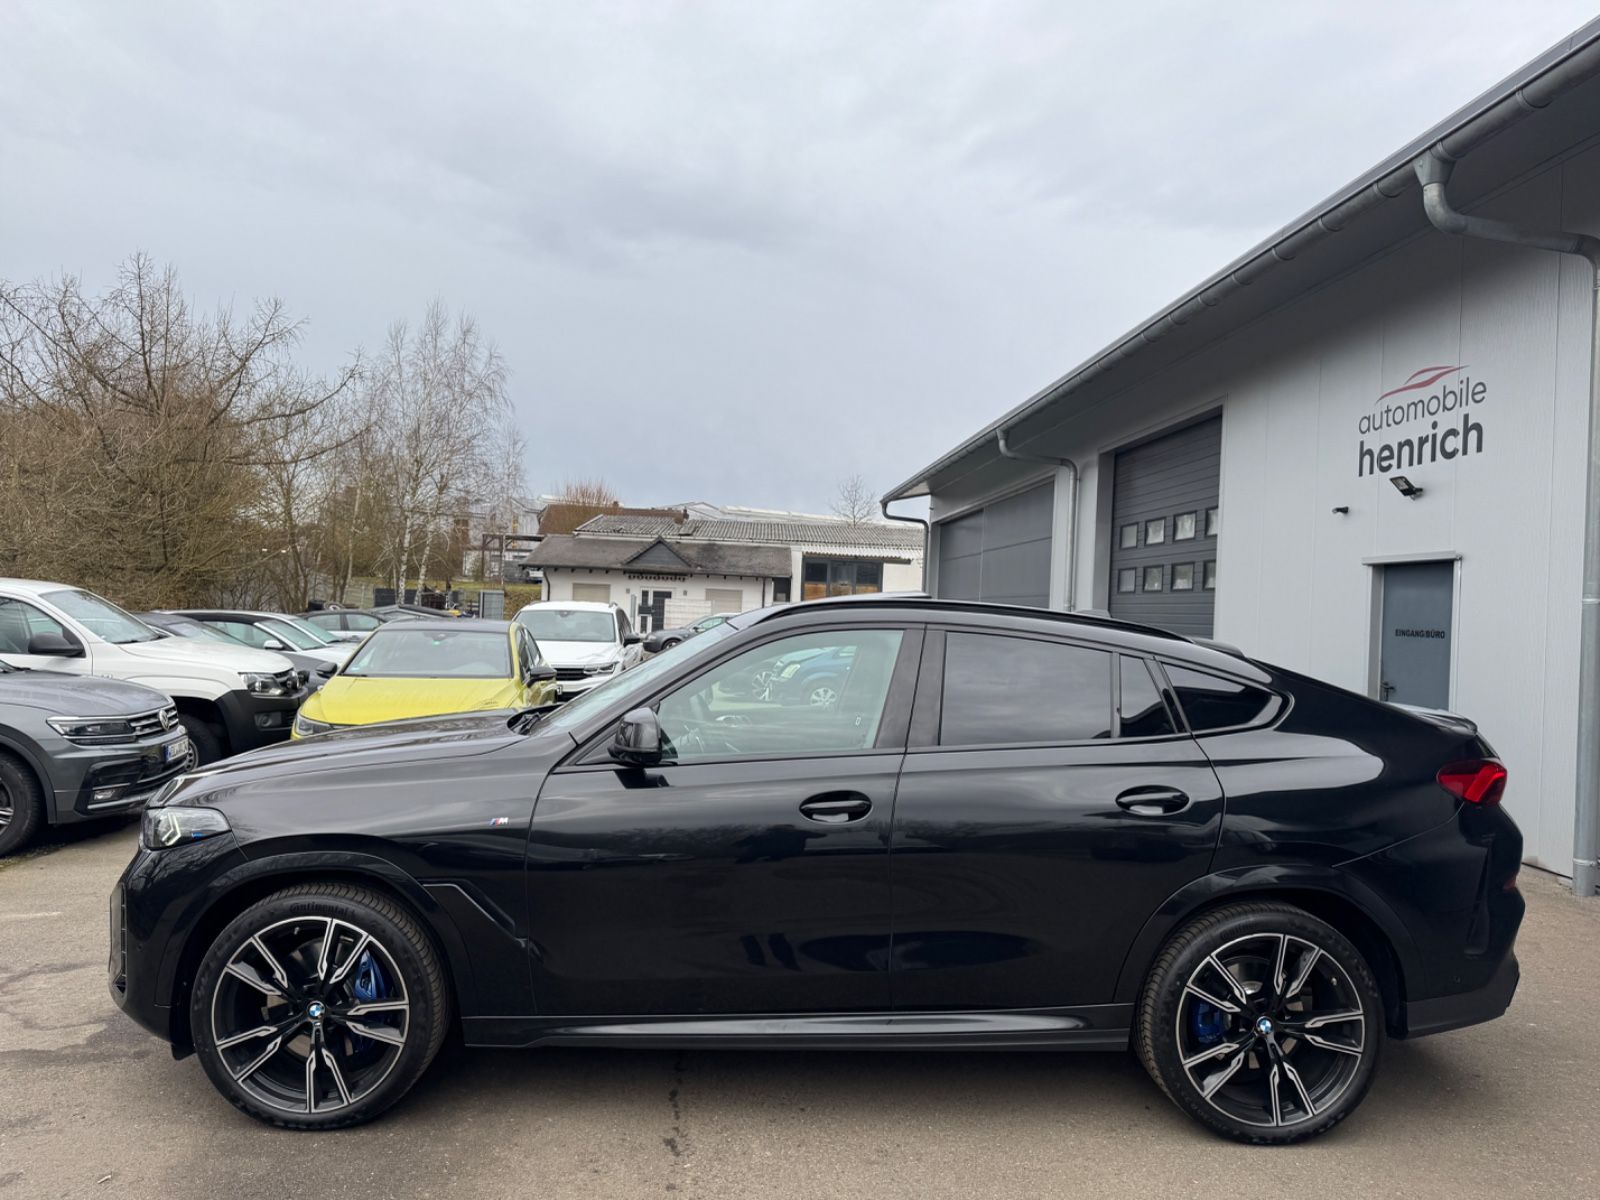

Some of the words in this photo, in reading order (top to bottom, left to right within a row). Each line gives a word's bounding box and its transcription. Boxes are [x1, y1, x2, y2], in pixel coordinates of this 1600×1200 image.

[1358, 376, 1487, 435] automobile
[1358, 413, 1483, 477] henrich
[1395, 629, 1424, 638] EINGANG
[1425, 629, 1445, 639] BÜRO
